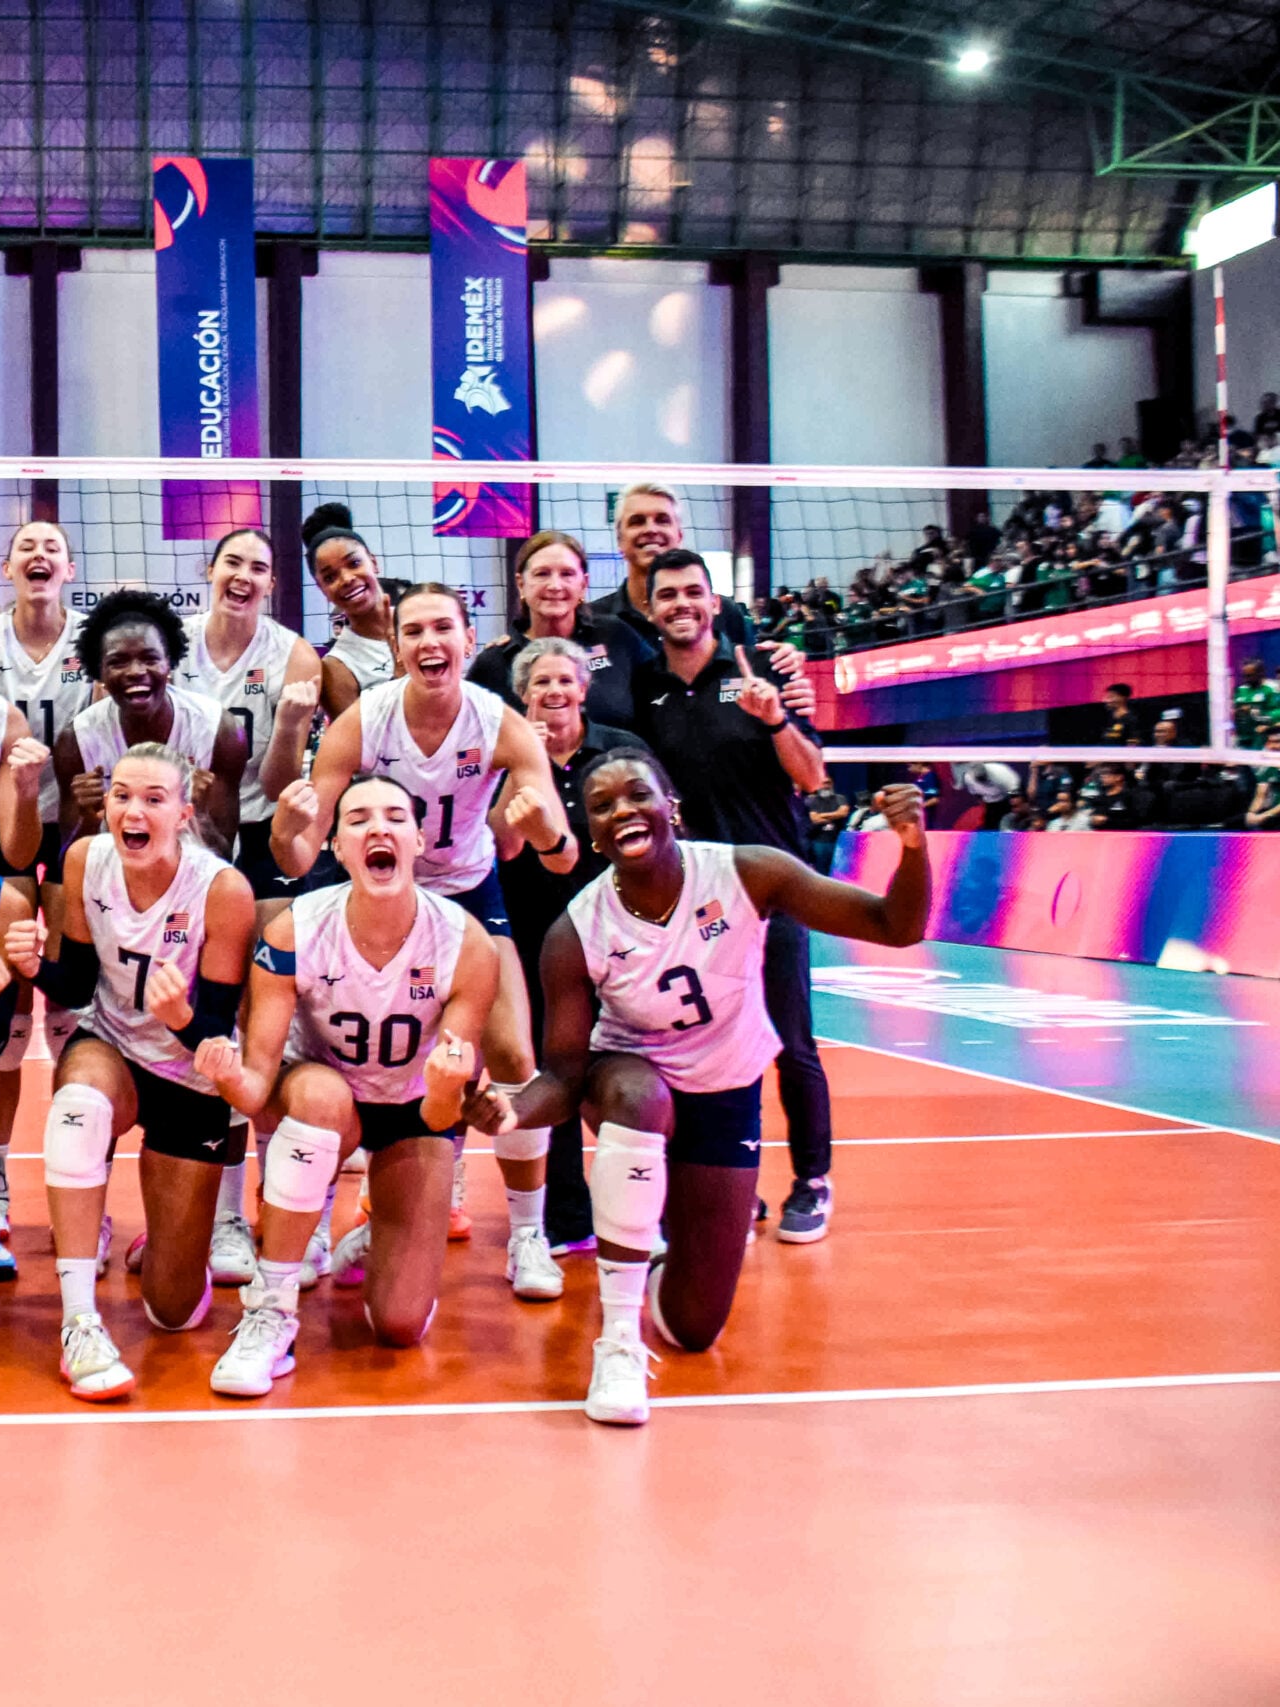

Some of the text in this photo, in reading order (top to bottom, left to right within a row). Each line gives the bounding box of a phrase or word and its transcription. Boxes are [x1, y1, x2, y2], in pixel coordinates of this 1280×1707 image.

[460, 276, 485, 362] IDEMÉX
[192, 310, 223, 459] EDUCACIÓN
[588, 656, 613, 672] USA
[60, 672, 83, 684] USA
[244, 683, 266, 696] USA
[456, 763, 482, 779] USA
[163, 929, 189, 945] USA
[700, 920, 730, 942] USA
[118, 947, 152, 1012] 7
[410, 985, 436, 1001] USA
[658, 964, 713, 1032] 3
[329, 1011, 422, 1068] 30
